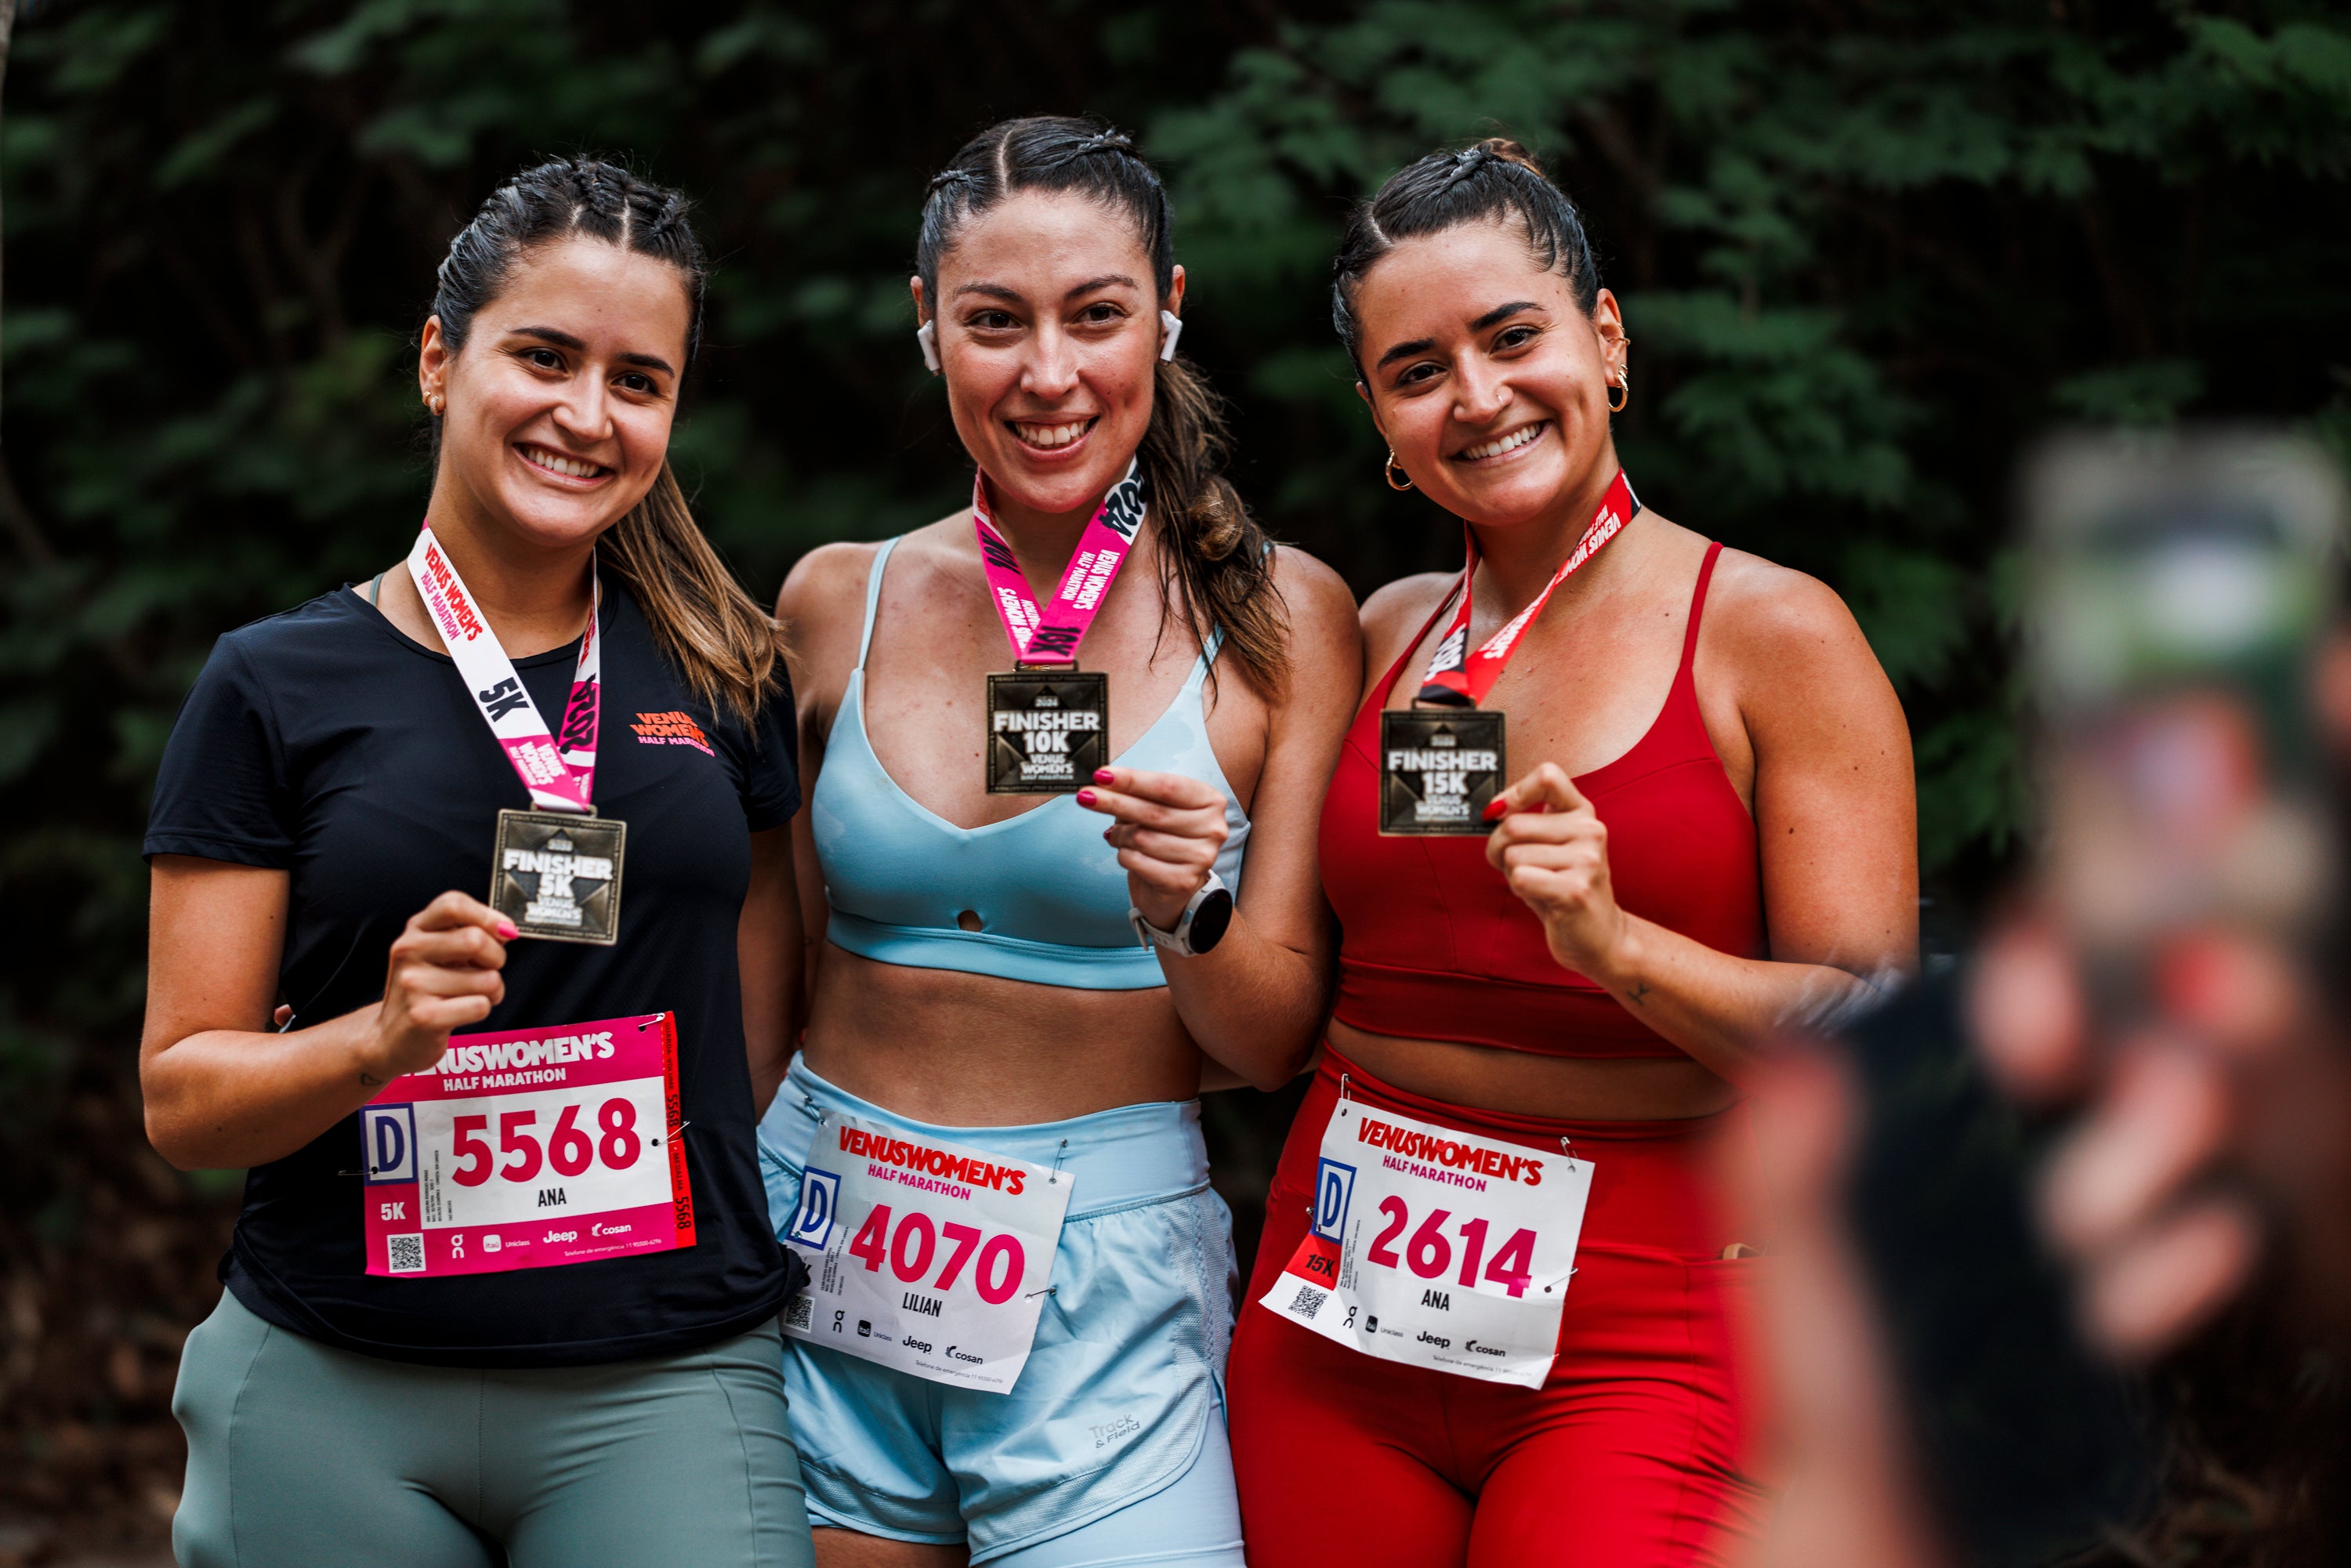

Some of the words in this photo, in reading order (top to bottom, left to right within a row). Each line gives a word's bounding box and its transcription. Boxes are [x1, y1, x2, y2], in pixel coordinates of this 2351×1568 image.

[1588, 512, 1621, 555] VENUS
[1077, 551, 1096, 570] HALF
[1096, 549, 1121, 579] VENUS
[425, 542, 449, 590] VENUS
[444, 580, 484, 641] WOMEN'S
[1060, 566, 1089, 601] MARATHON
[1073, 575, 1109, 610] WOMEN'S
[421, 570, 434, 595] HALF
[431, 592, 461, 641] MARATHON
[1029, 625, 1082, 657] 10K
[480, 676, 530, 723] 5K
[560, 672, 596, 755] 2024
[994, 711, 1100, 732] FINISHER
[1023, 731, 1071, 753] 10K
[538, 743, 566, 777] VENUS
[1020, 762, 1074, 775] WOMEN'S
[1030, 754, 1066, 764] VENUS
[1388, 750, 1498, 771] FINISHER
[1422, 772, 1469, 795] 15K
[502, 848, 614, 881] FINISHER
[538, 874, 575, 898] 5K
[401, 1031, 614, 1077] NUSWOMEN'S
[444, 1077, 480, 1092] HALF
[482, 1067, 567, 1088] MARATHON
[667, 1094, 679, 1128] 5568
[375, 1116, 404, 1172] D
[452, 1097, 641, 1187] 5568
[1358, 1117, 1544, 1186] VENUSWOMEN'S
[674, 1153, 684, 1190] MEDALHA
[839, 1126, 1027, 1195] VENUSWOMEN'S
[1382, 1155, 1408, 1174] HALF
[1410, 1162, 1487, 1192] MARATHON
[868, 1164, 897, 1182] HALF
[898, 1172, 971, 1200] MARATHON
[381, 1202, 406, 1221] 5K
[538, 1188, 567, 1208] ANA
[676, 1196, 691, 1229] 5568
[802, 1179, 828, 1233] D
[1323, 1171, 1342, 1228] D
[543, 1230, 578, 1243] Jeep
[602, 1224, 632, 1235] cosan
[849, 1204, 1025, 1305] 4070
[1367, 1195, 1537, 1298] 2614
[1306, 1254, 1335, 1277] 15K
[902, 1292, 942, 1317] LILIAN
[1422, 1289, 1450, 1311] ANA
[903, 1335, 932, 1353] Jeep
[1381, 1327, 1404, 1337] Uniclass
[1417, 1331, 1451, 1349] Jeep
[955, 1352, 984, 1365] cosan
[1476, 1345, 1505, 1357] cosan
[1089, 1414, 1134, 1438] Track
[1107, 1421, 1140, 1443] Field
